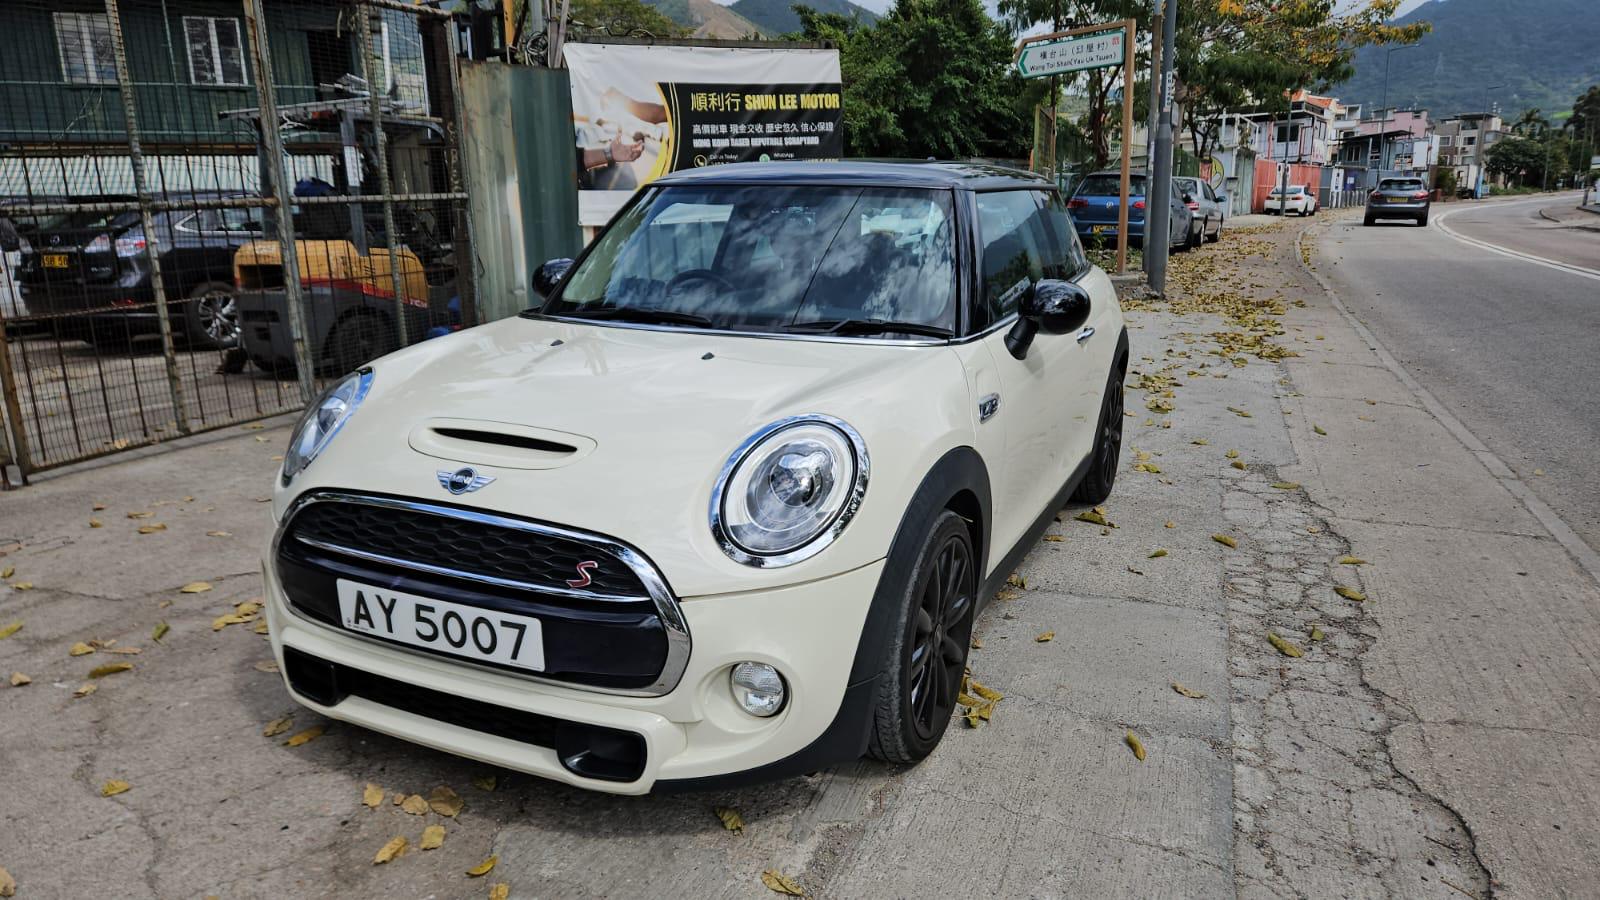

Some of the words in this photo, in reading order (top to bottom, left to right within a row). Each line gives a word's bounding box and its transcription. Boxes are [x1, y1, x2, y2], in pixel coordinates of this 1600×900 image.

[691, 92, 741, 112] 順利行
[745, 94, 776, 110] SHUN
[779, 94, 798, 110] LEE
[801, 93, 840, 109] MOTOR
[565, 560, 598, 588] S
[353, 590, 397, 634] AY
[415, 603, 527, 661] 5007
